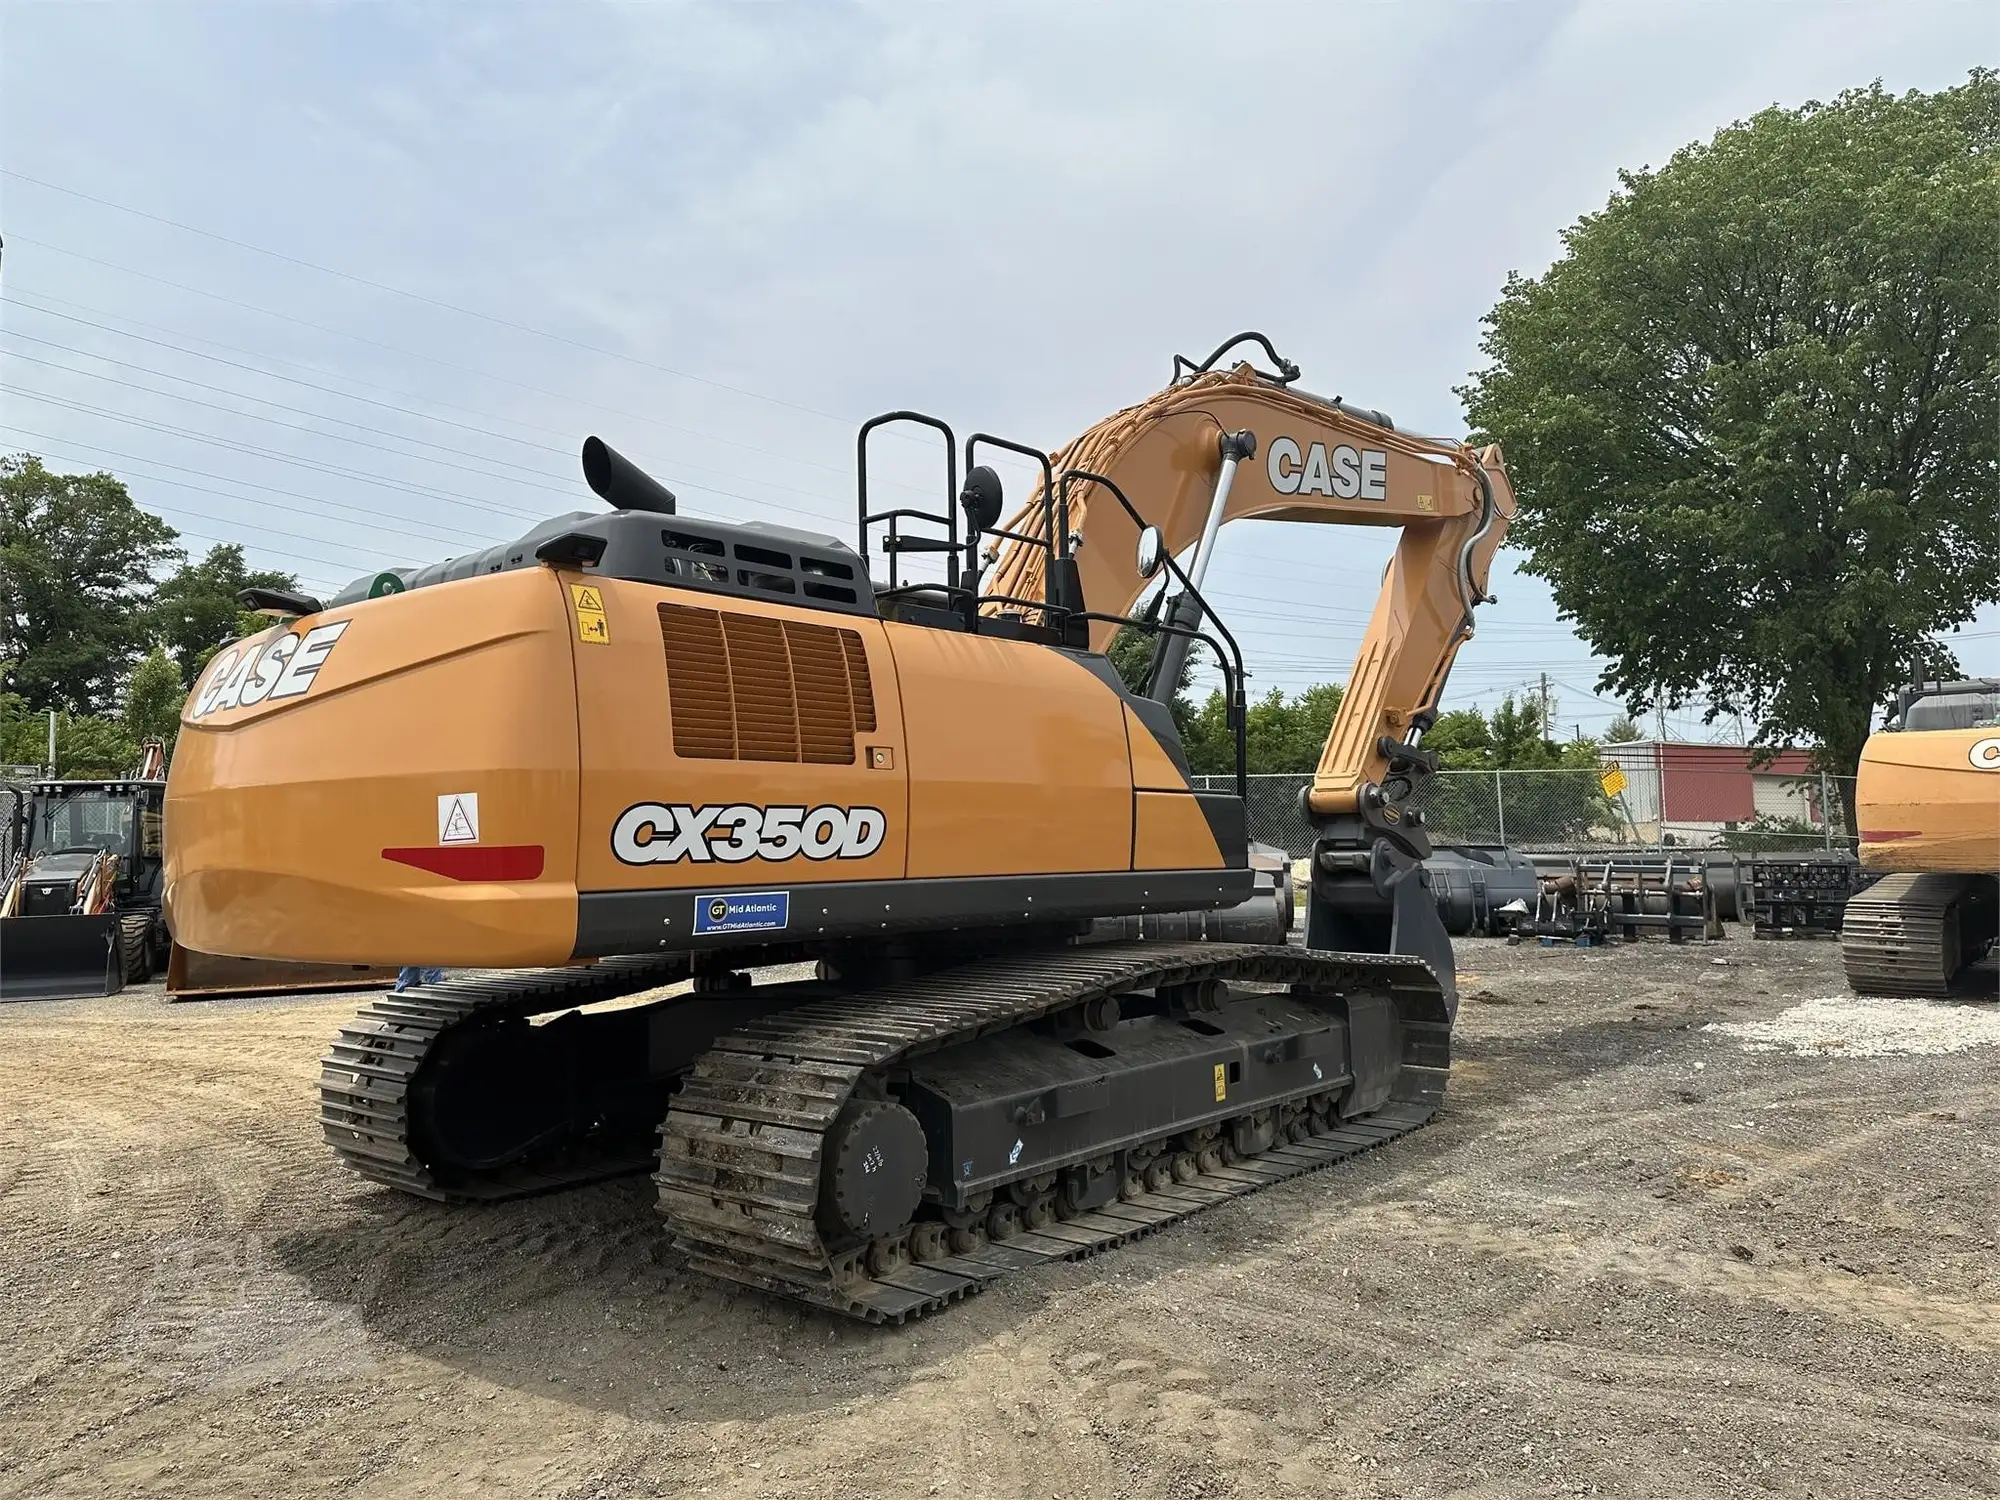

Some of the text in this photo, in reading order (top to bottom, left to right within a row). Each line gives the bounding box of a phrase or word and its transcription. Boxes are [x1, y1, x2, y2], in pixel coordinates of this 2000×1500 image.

[1267, 436, 1387, 501] CASE
[193, 619, 353, 719] CASE
[610, 801, 886, 866] CX350D
[706, 921, 776, 930] www.GTMidAtlantic.com
[711, 903, 777, 915] GT Mid Atlantic
